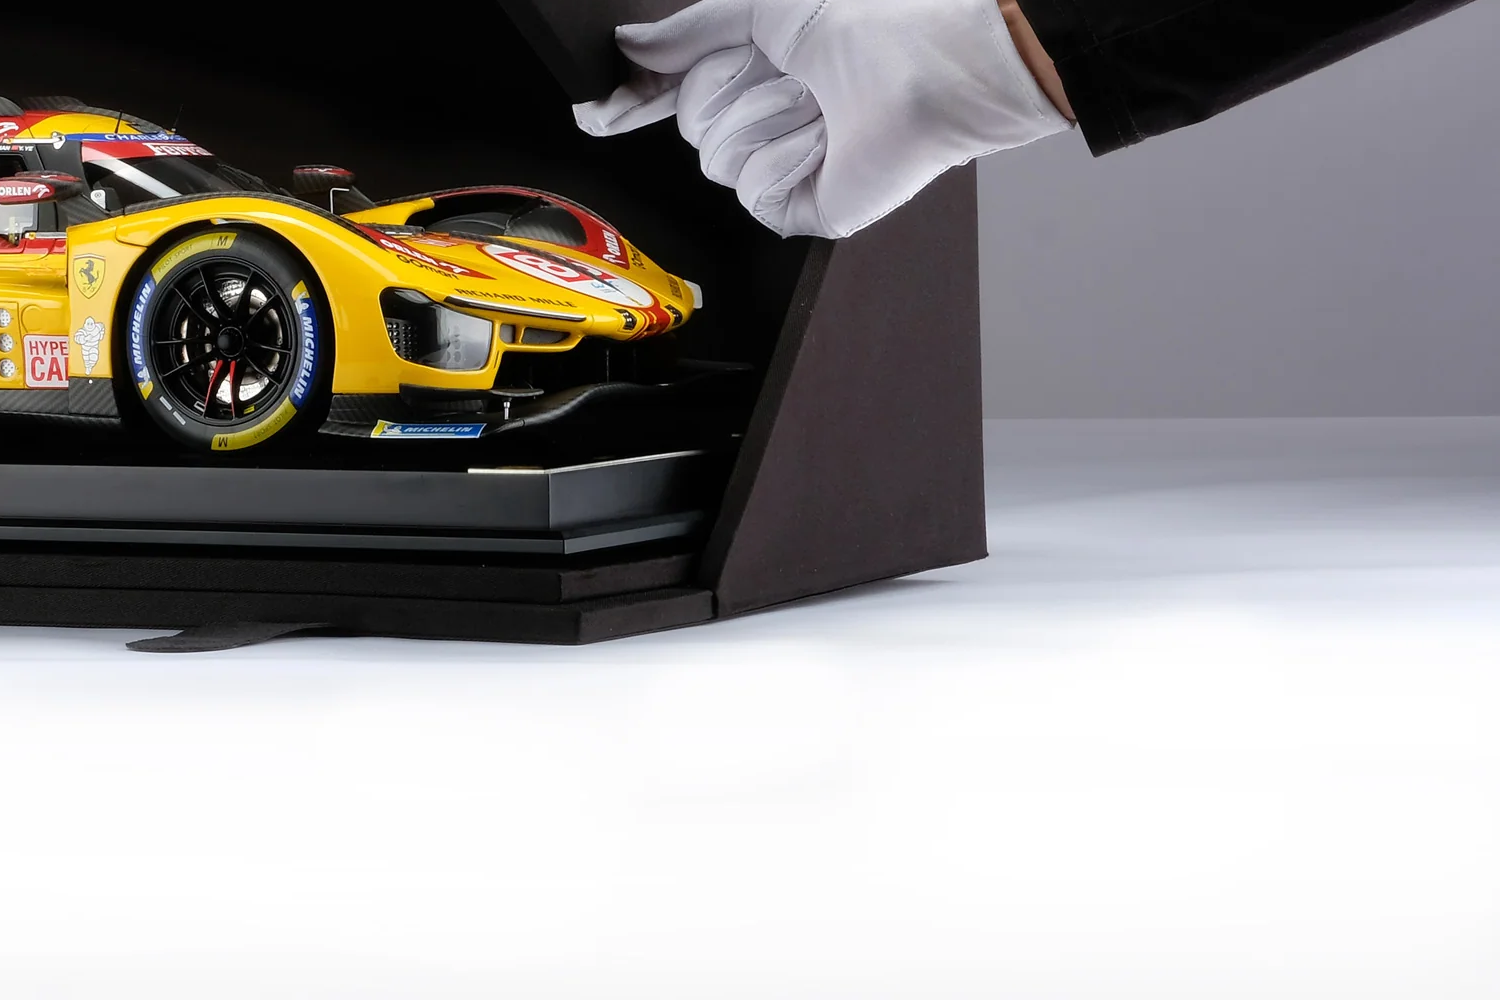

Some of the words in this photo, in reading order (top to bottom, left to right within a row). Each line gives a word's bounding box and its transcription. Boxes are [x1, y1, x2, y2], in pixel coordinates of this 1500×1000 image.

[217, 235, 229, 247] M
[455, 288, 526, 302] RICHARD
[529, 296, 578, 308] MILLE
[132, 282, 152, 365] MICHELIN
[294, 316, 315, 400] MICHELIN
[218, 437, 228, 448] M
